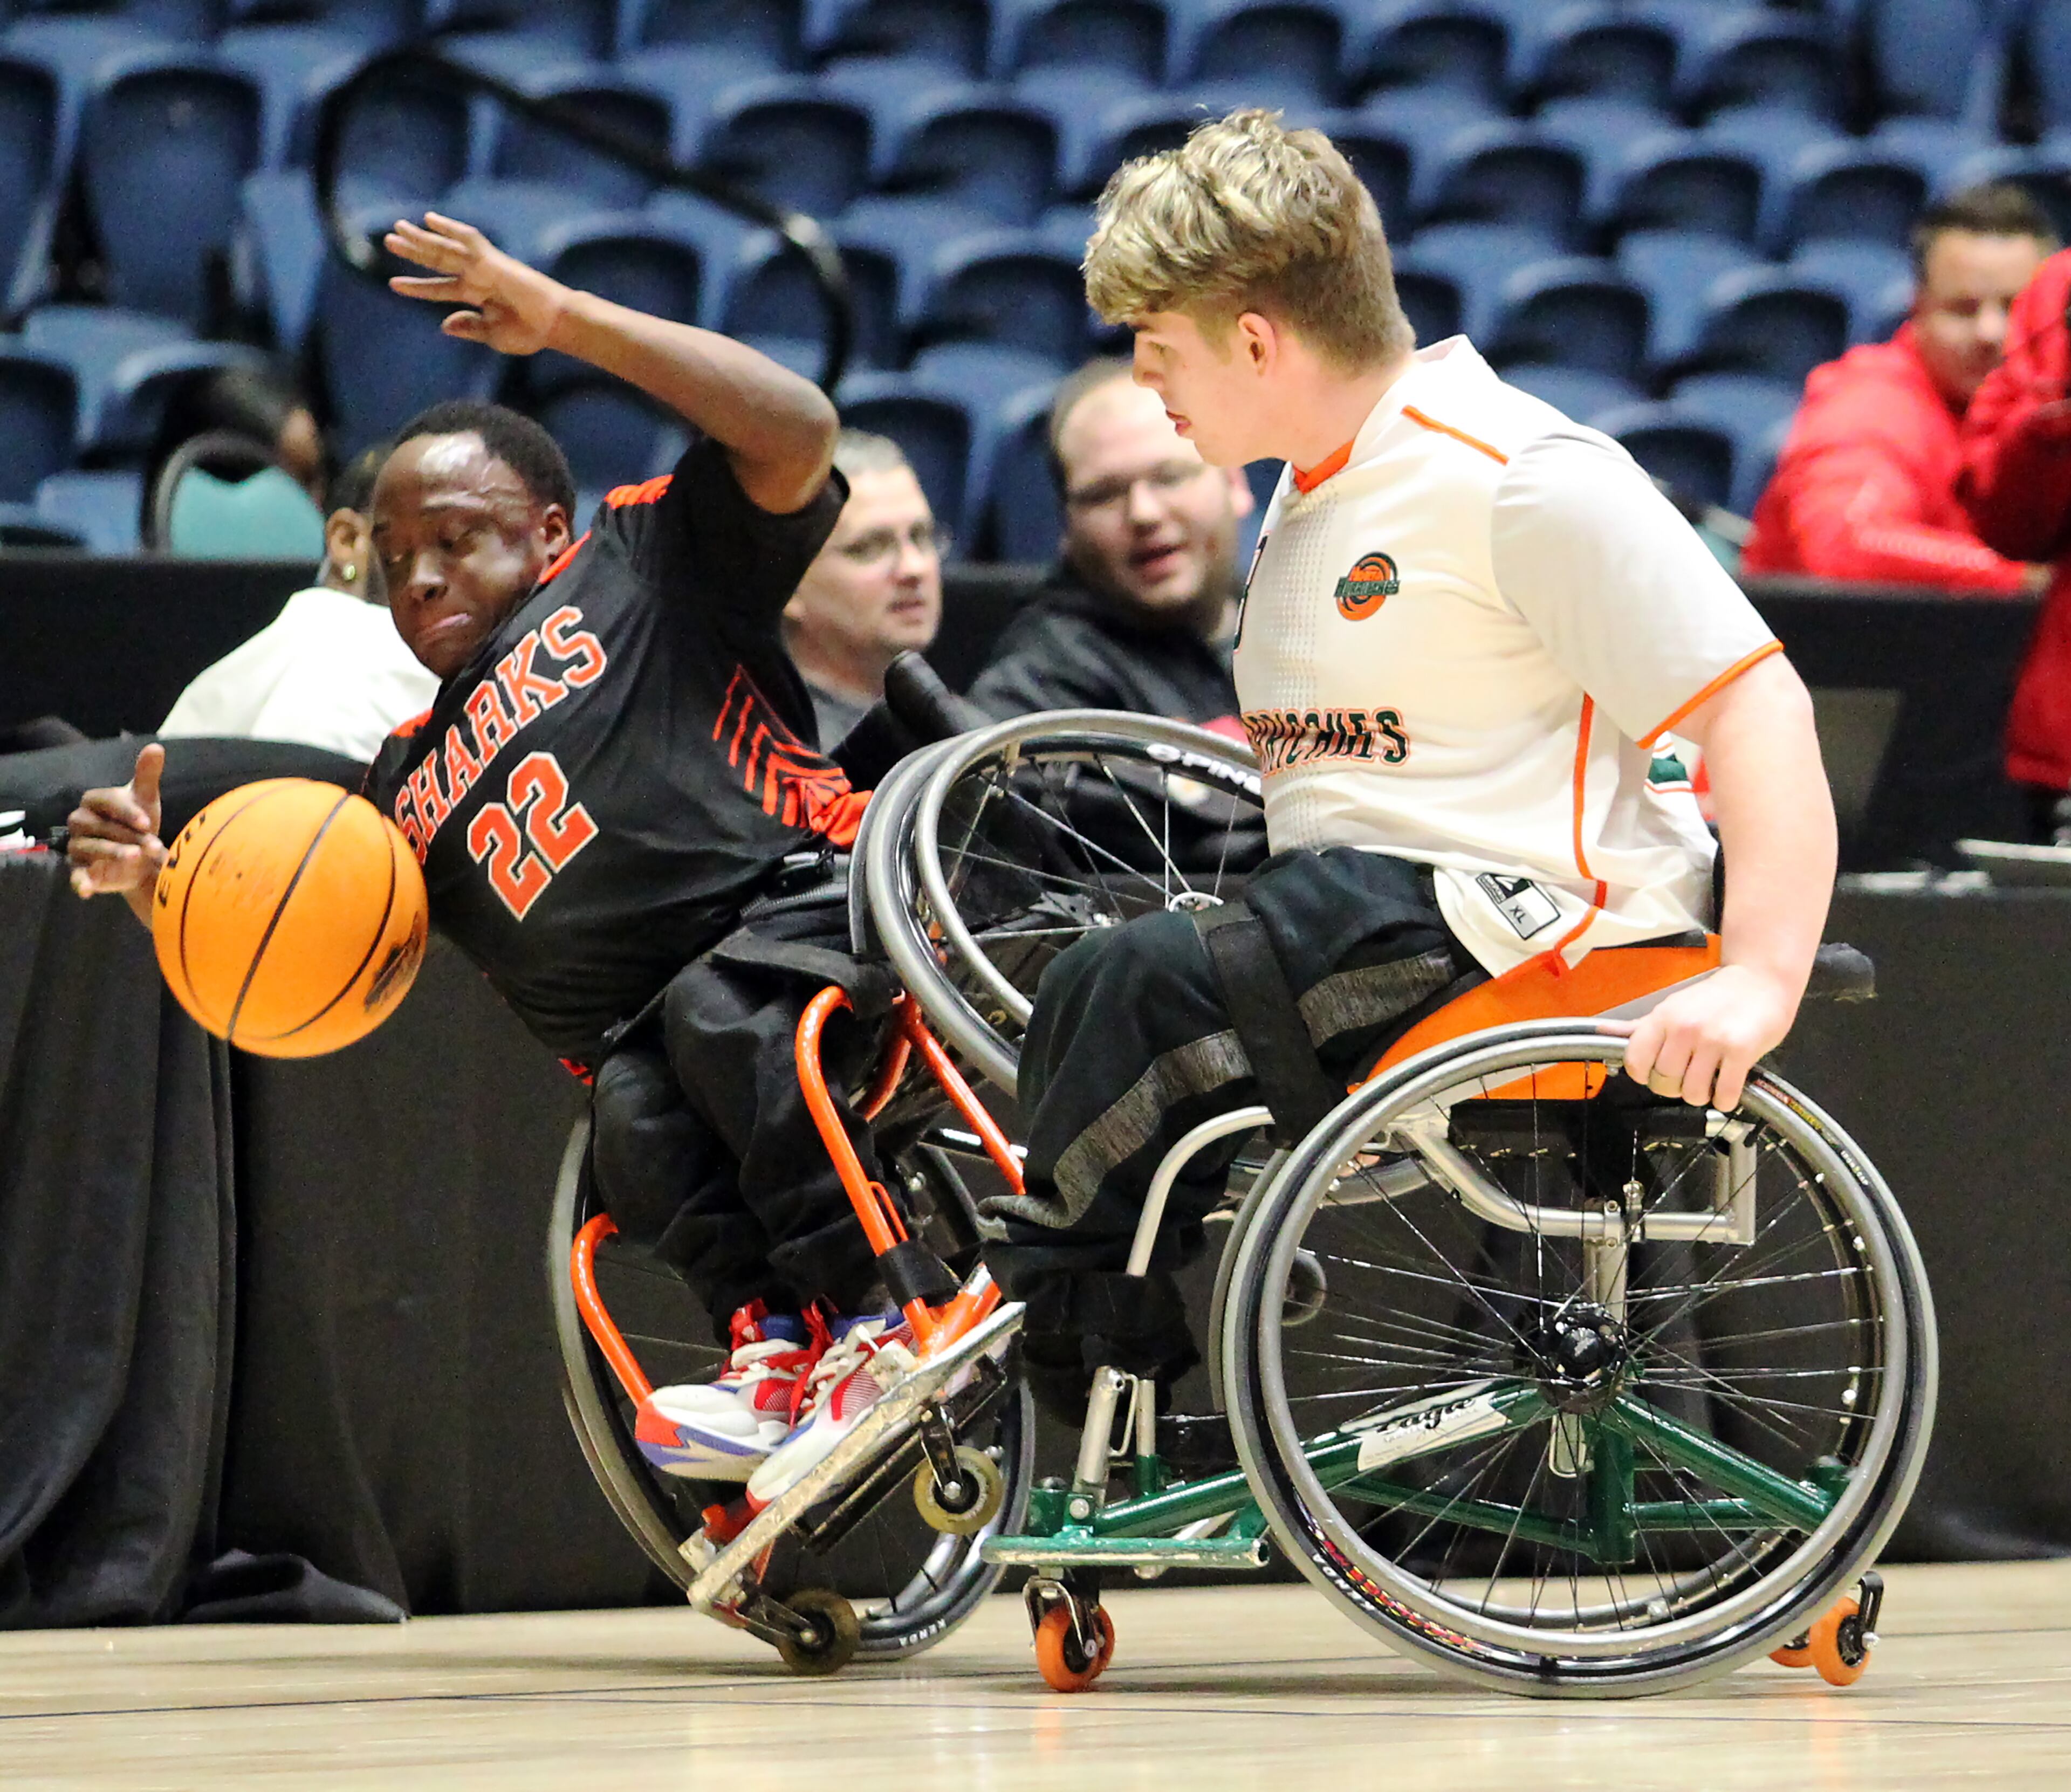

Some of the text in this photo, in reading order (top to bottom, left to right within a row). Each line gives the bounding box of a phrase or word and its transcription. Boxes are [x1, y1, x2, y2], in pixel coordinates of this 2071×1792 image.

[395, 605, 608, 865] SHARKS
[467, 751, 599, 923] 22
[1509, 905, 1526, 924] XL
[1312, 1553, 1375, 1611] KENDA
